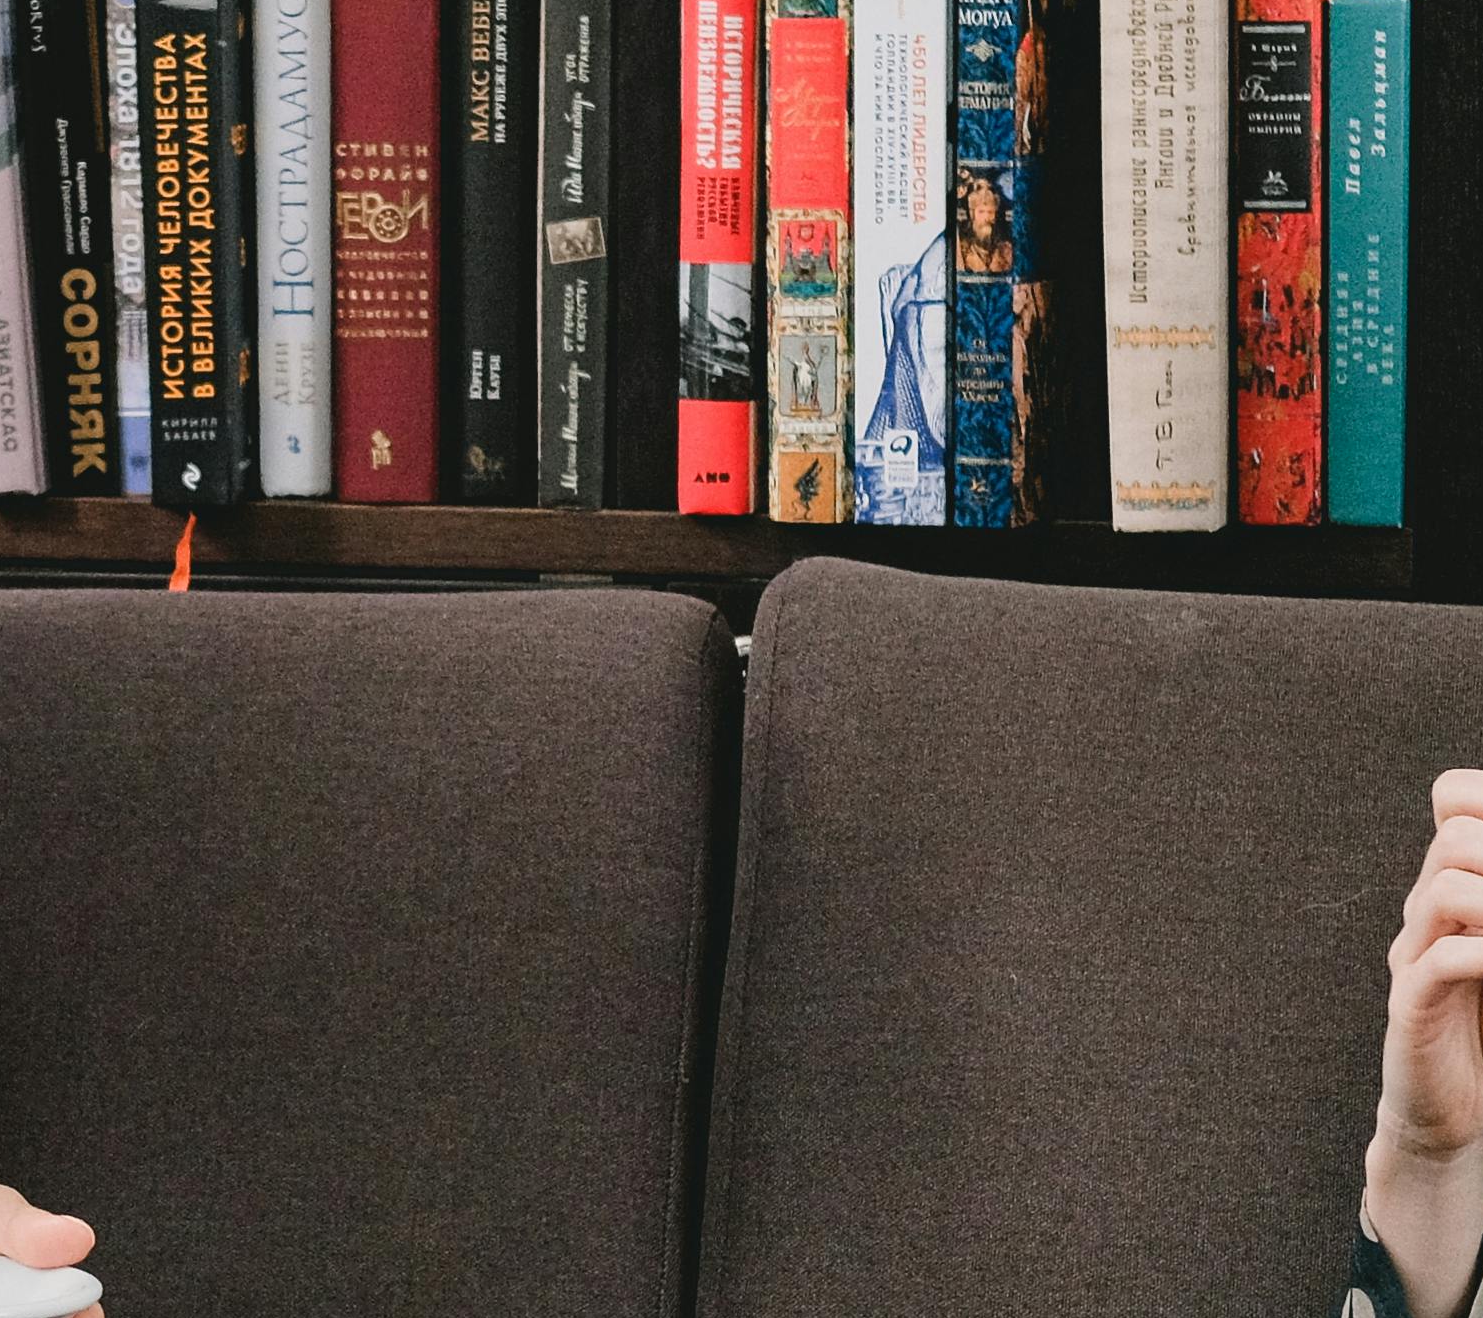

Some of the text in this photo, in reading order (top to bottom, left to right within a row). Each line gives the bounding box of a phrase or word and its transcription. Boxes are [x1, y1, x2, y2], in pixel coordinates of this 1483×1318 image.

[494, 24, 508, 61] ДВУХ
[958, 8, 1012, 27] МОРУА
[113, 22, 140, 123] Эпоха
[494, 63, 507, 118] РУБЕЖЕ
[695, 0, 717, 168] НЕИЗБЕЖНОСТЬ?
[721, 15, 744, 168] ИСТОРИЧЕСКАЯ
[874, 46, 883, 68] ЧТО
[874, 74, 883, 88] ЗА
[1152, 22, 1177, 97] Древней
[1371, 30, 1387, 157] Зальцман
[469, 69, 490, 141] МАКС
[494, 122, 507, 141] НА
[874, 95, 883, 121] НИМ
[898, 33, 909, 217] ТЕХНОЛОГИЧЕСКИЙ РАСЦВЕТ
[911, 33, 926, 223] 450 ЛЕТ ЛИДЕРСТВА
[1157, 108, 1173, 116] и
[118, 135, 142, 209] 1812
[335, 141, 428, 160] СТИВЕН
[873, 127, 883, 224] ПОСЛЕДОВАЛО
[1154, 127, 1173, 188] Англии
[1345, 117, 1361, 195] Павел
[74, 161, 94, 254] Кармело Сардо
[153, 34, 184, 398] ИСТОРИЯ ЧЕЛОВЕЧЕСТВА
[184, 33, 215, 397] В ВЕЛИКИХ ДОКУМЕНТАХ
[1129, 158, 1151, 302] Историописание
[115, 218, 144, 294] года
[1335, 271, 1348, 384] СРЕДНЯЯ
[1351, 300, 1364, 361] АЗИЯ
[1366, 232, 1379, 373] В СРЕДНИЕ
[60, 267, 106, 476] СОРНЯК
[1382, 324, 1394, 384] ВЕКА
